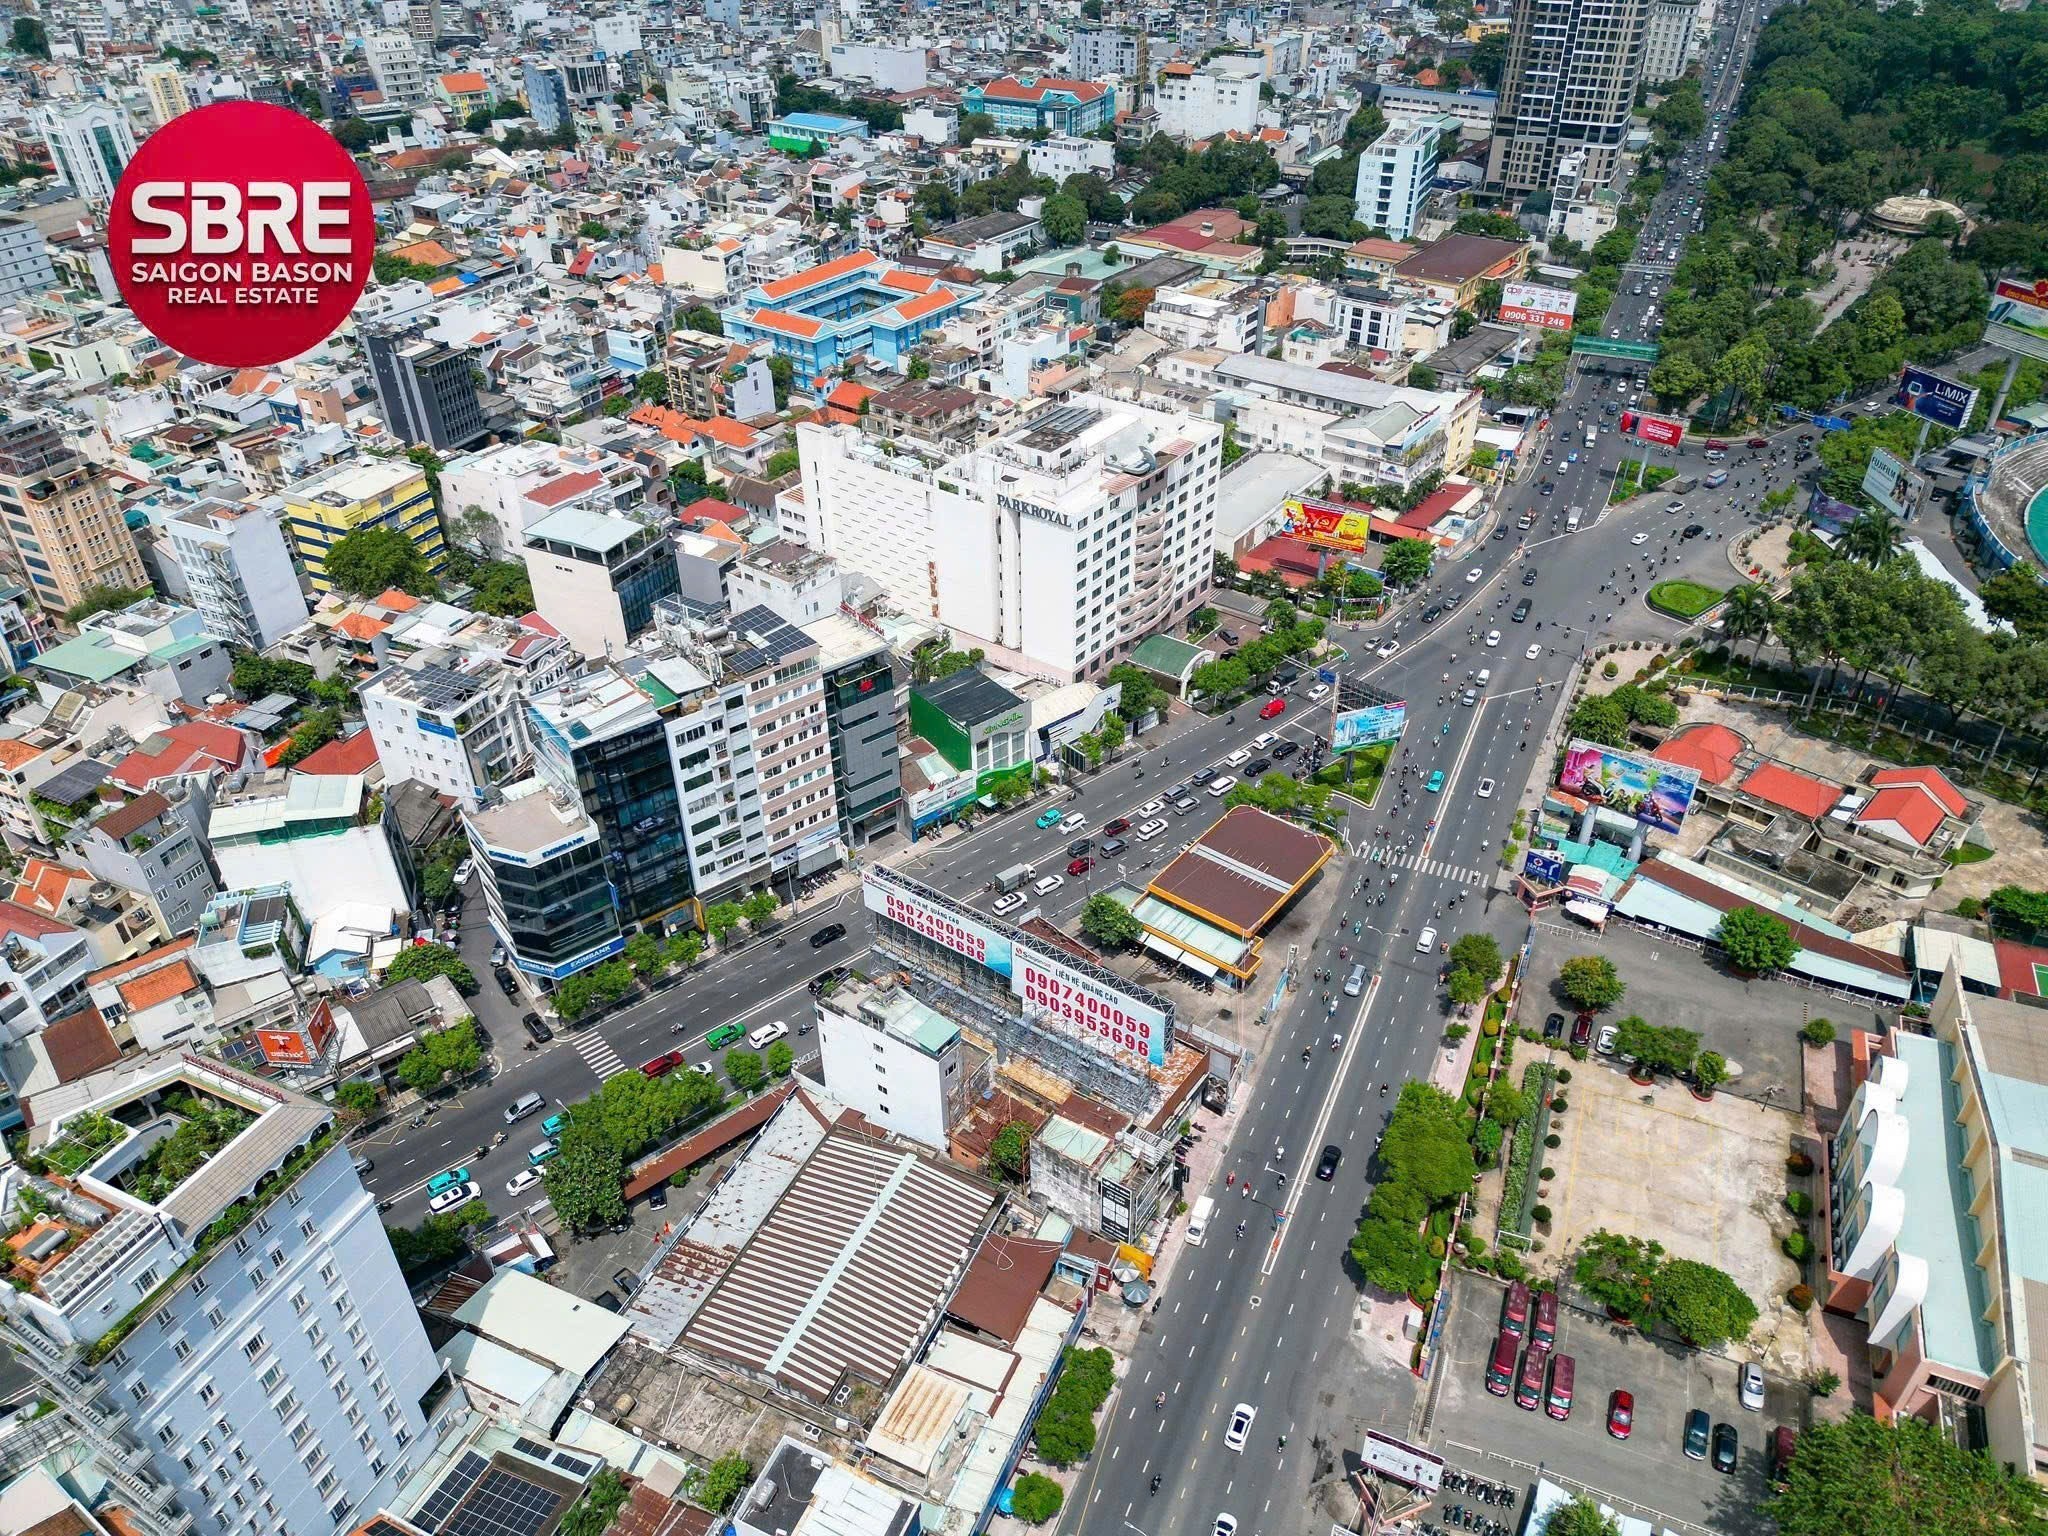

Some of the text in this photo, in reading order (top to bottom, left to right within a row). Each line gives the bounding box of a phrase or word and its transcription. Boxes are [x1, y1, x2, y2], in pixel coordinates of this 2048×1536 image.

[1504, 310, 1565, 327] 0906 331 246
[996, 493, 1072, 528] PARKROYAL
[541, 836, 585, 858] EXIMBANK
[886, 894, 985, 950] 0907400059
[887, 907, 985, 963] 0903953696
[570, 945, 611, 968] EXIMBANK
[1055, 968, 1070, 982] LIÊN
[1071, 974, 1080, 987] HỆ
[1081, 980, 1104, 998] QUẢNG
[1025, 967, 1150, 1039] 0907400059
[1025, 985, 1149, 1057] 0903953696
